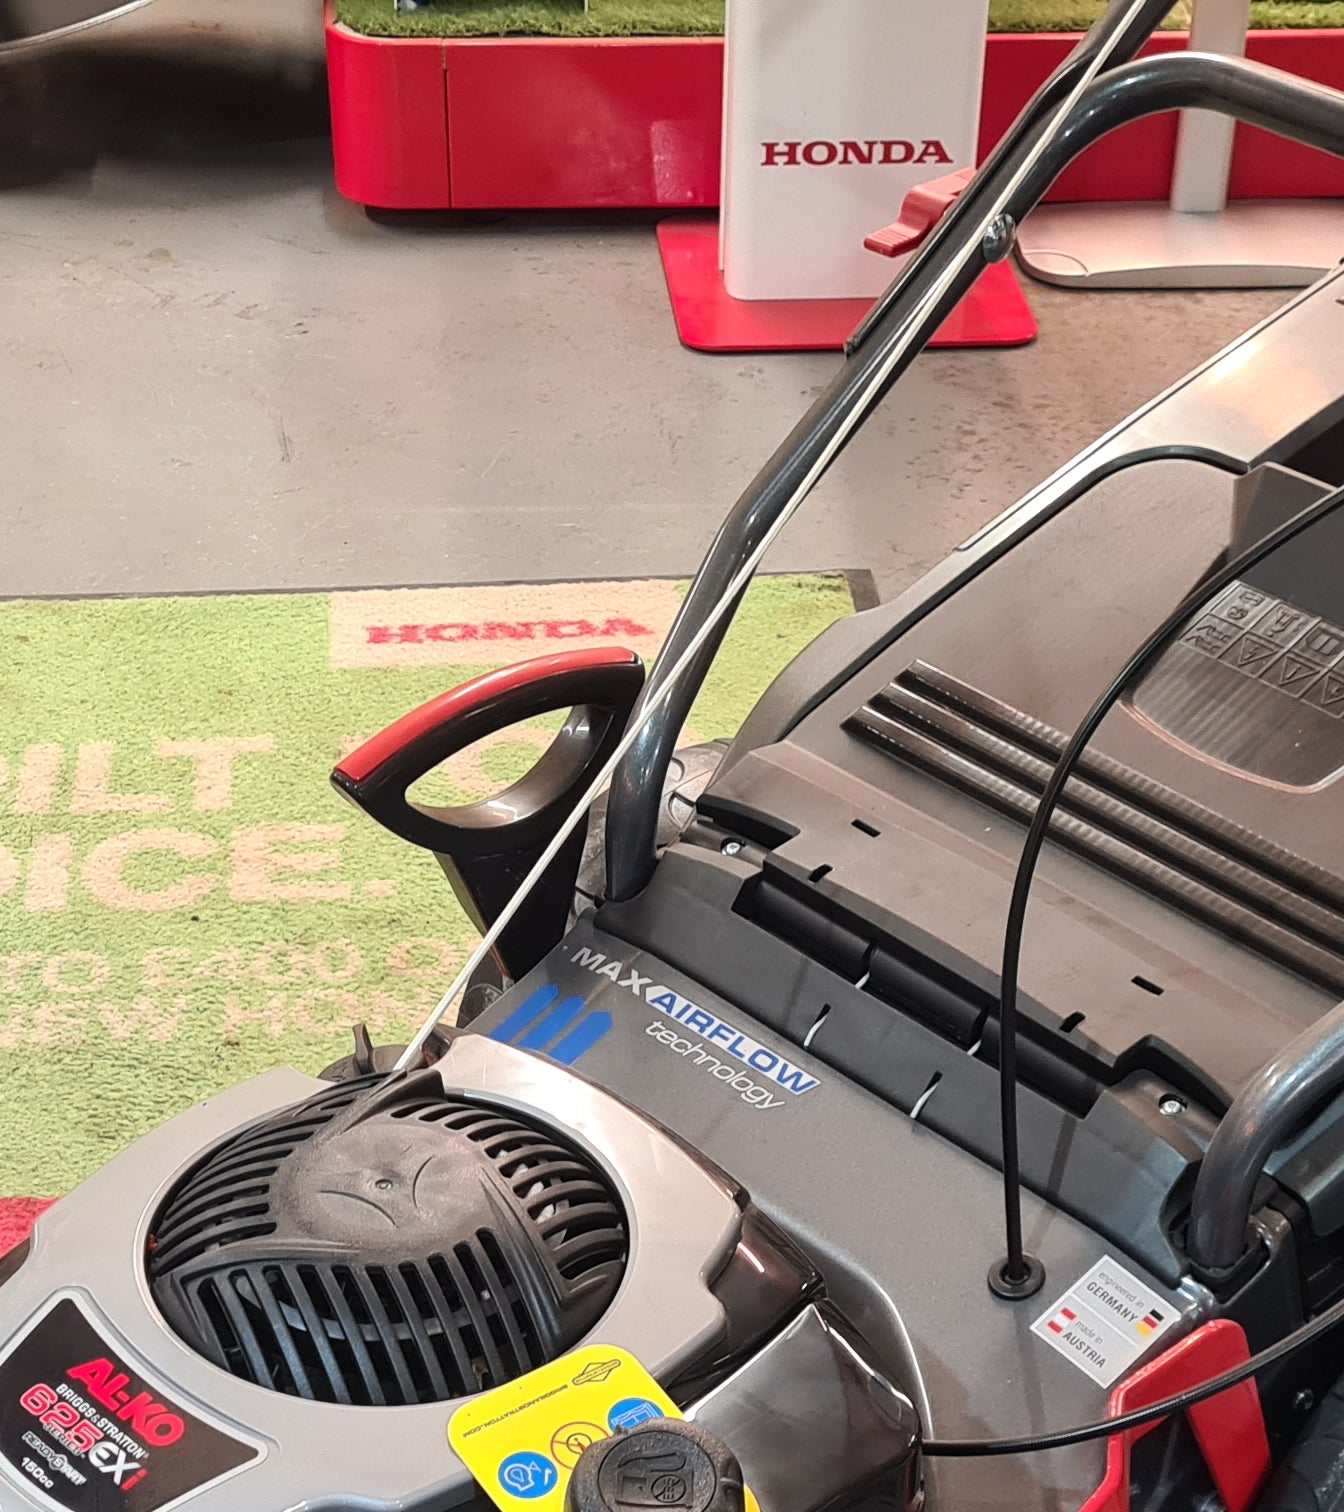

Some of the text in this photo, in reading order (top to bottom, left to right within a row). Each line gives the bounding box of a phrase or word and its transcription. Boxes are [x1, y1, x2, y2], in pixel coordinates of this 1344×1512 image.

[760, 138, 955, 167] HONDA
[365, 617, 656, 645] HONDA
[570, 946, 818, 1095] MAX AIRFLOW
[643, 1019, 787, 1111] technology
[1086, 1281, 1140, 1324] GERMANY
[1097, 1271, 1146, 1309] engineered in
[1061, 1331, 1107, 1369] AUSTRIA
[1074, 1319, 1105, 1345] made in
[65, 1356, 186, 1447] AL-KO
